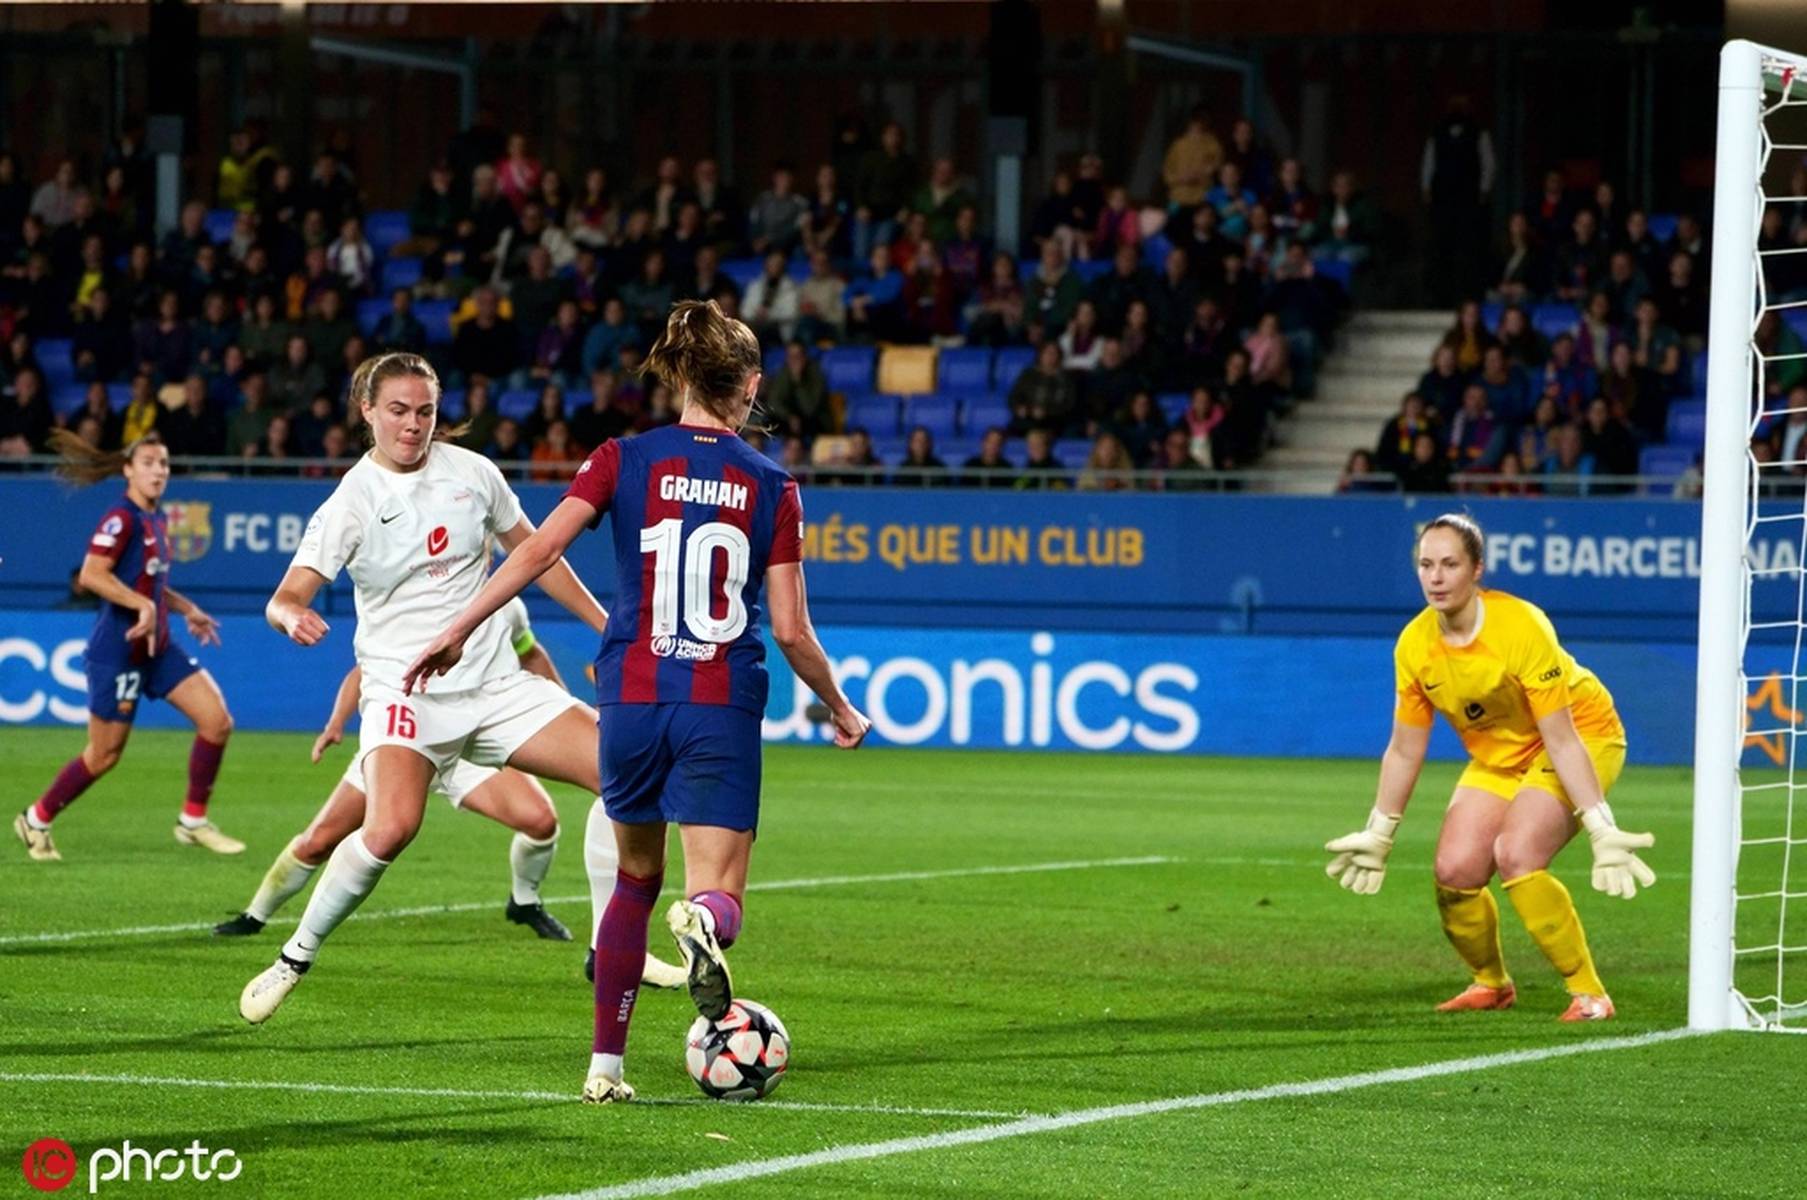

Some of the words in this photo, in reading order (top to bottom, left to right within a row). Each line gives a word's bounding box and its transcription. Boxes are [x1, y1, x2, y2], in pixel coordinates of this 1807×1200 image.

[660, 474, 748, 511] GRAHAM
[224, 513, 271, 552] FC
[878, 523, 961, 572] QUE
[970, 525, 1030, 566] UN
[1038, 525, 1144, 567] CLUB
[1486, 533, 1536, 575] FC
[1543, 535, 1800, 580] BARCELNA
[639, 518, 751, 643] 10
[115, 670, 141, 700] 12
[386, 703, 417, 740] 15
